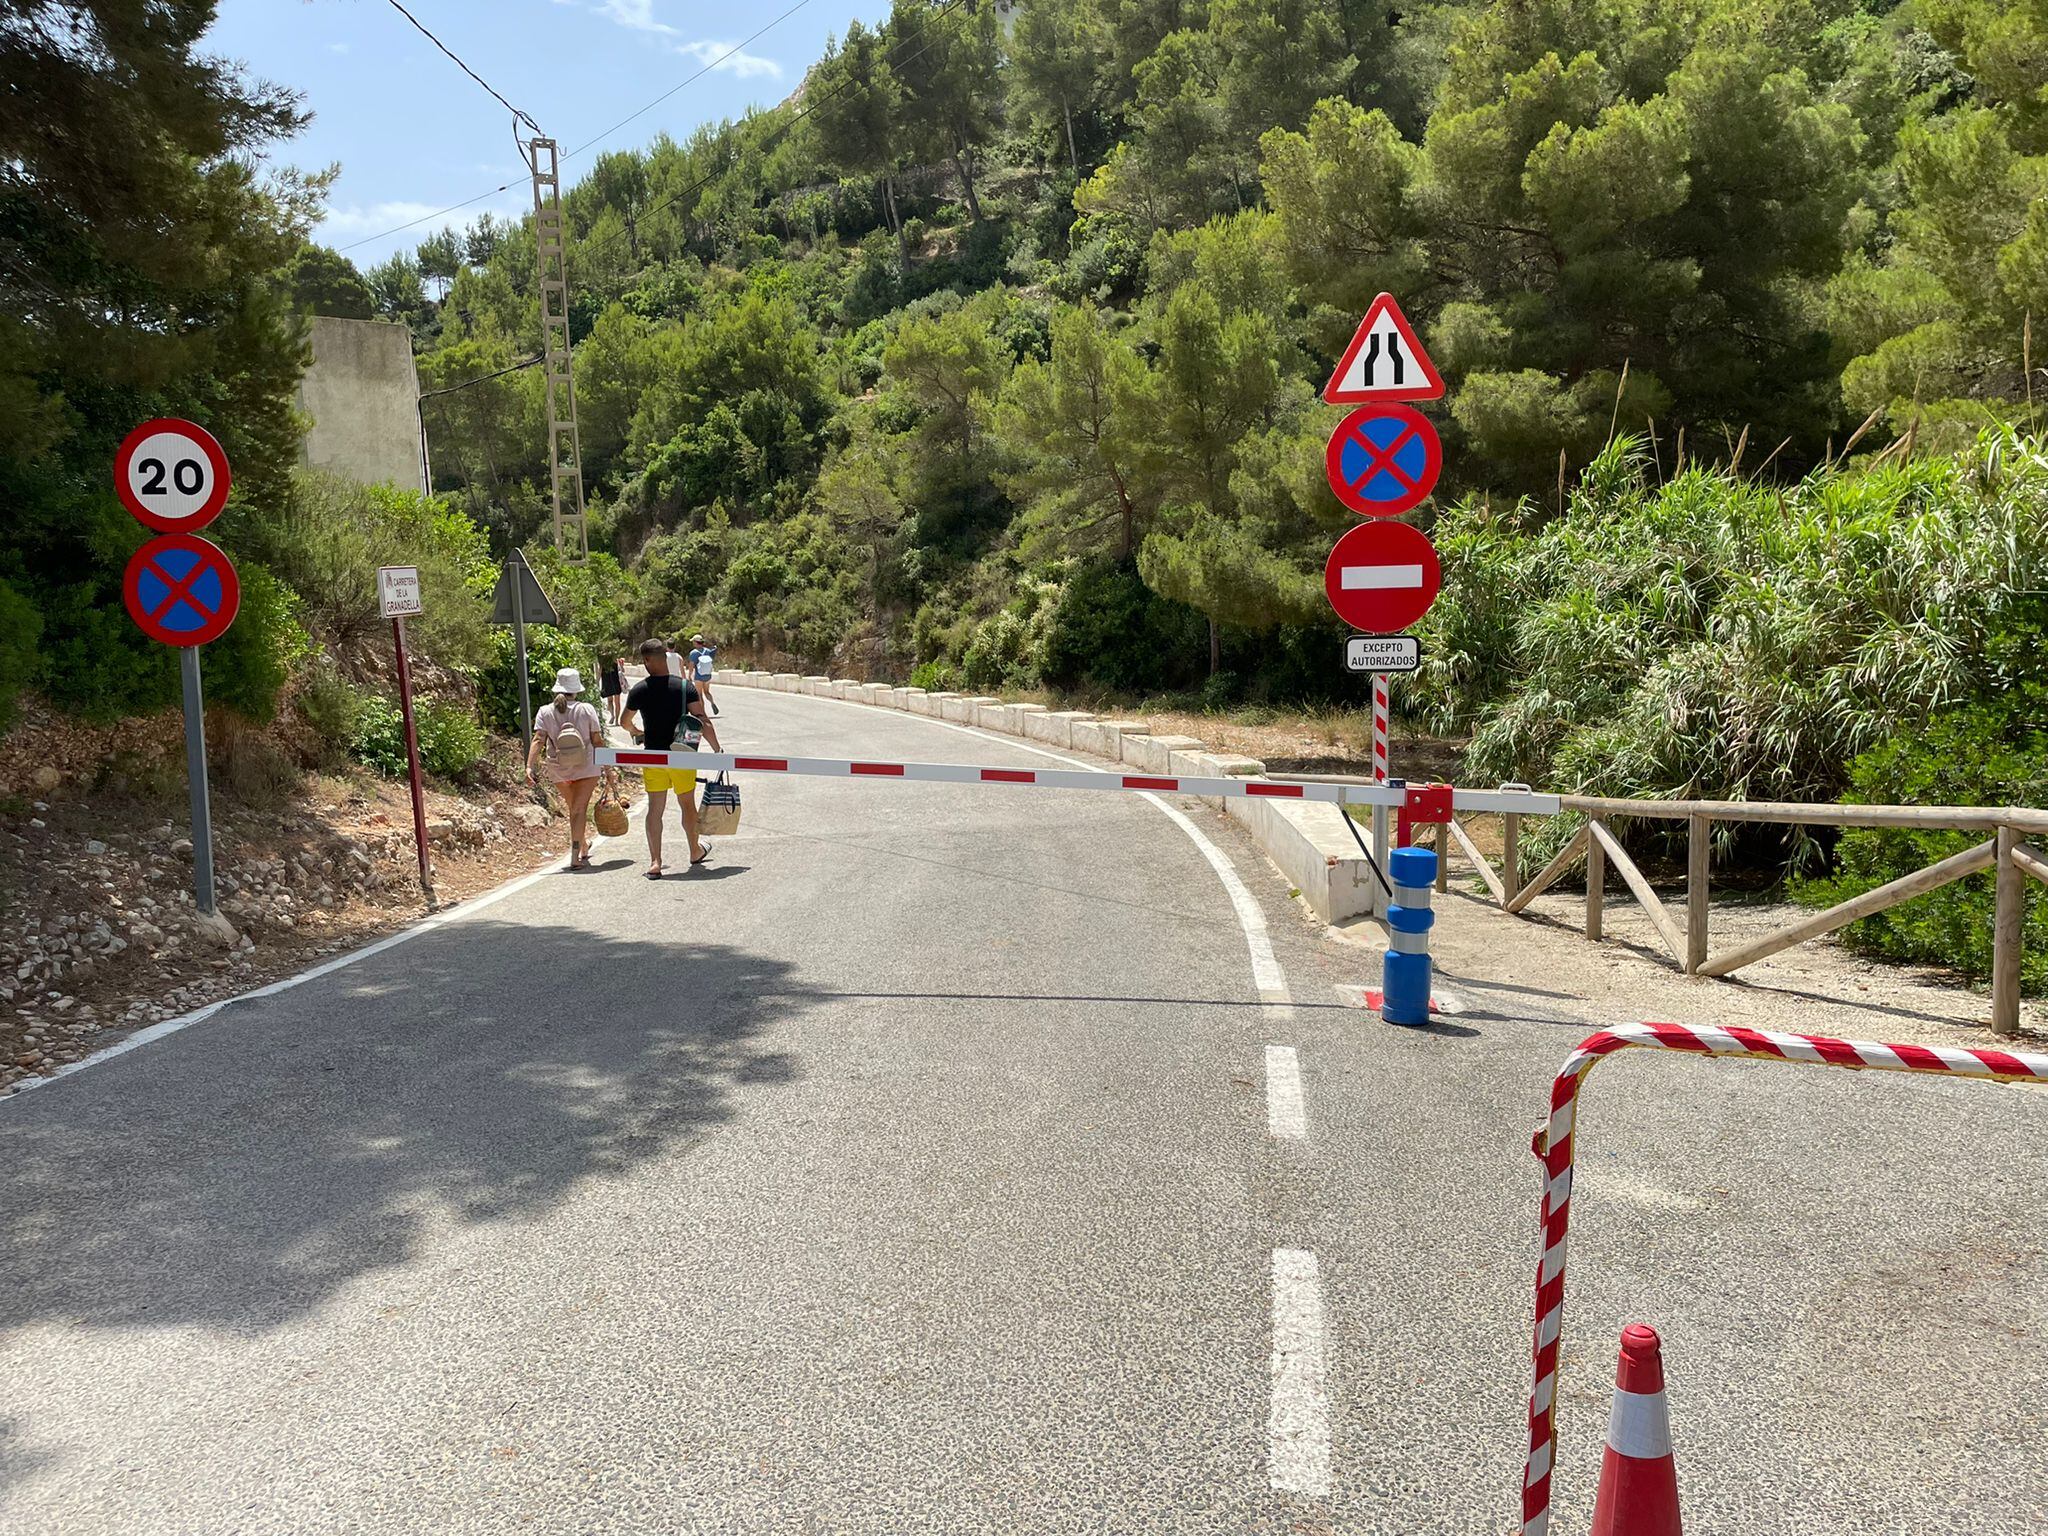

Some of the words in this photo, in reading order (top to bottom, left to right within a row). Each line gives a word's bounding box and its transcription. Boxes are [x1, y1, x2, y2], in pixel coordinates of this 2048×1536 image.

[138, 458, 204, 496] 20
[393, 577, 416, 586] CARRETERA
[396, 589, 402, 598] DE
[402, 589, 408, 598] LA
[387, 600, 419, 612] GRANADELLA
[1363, 643, 1403, 653] EXCEPTO
[1351, 656, 1415, 666] AUTORIZADOS
